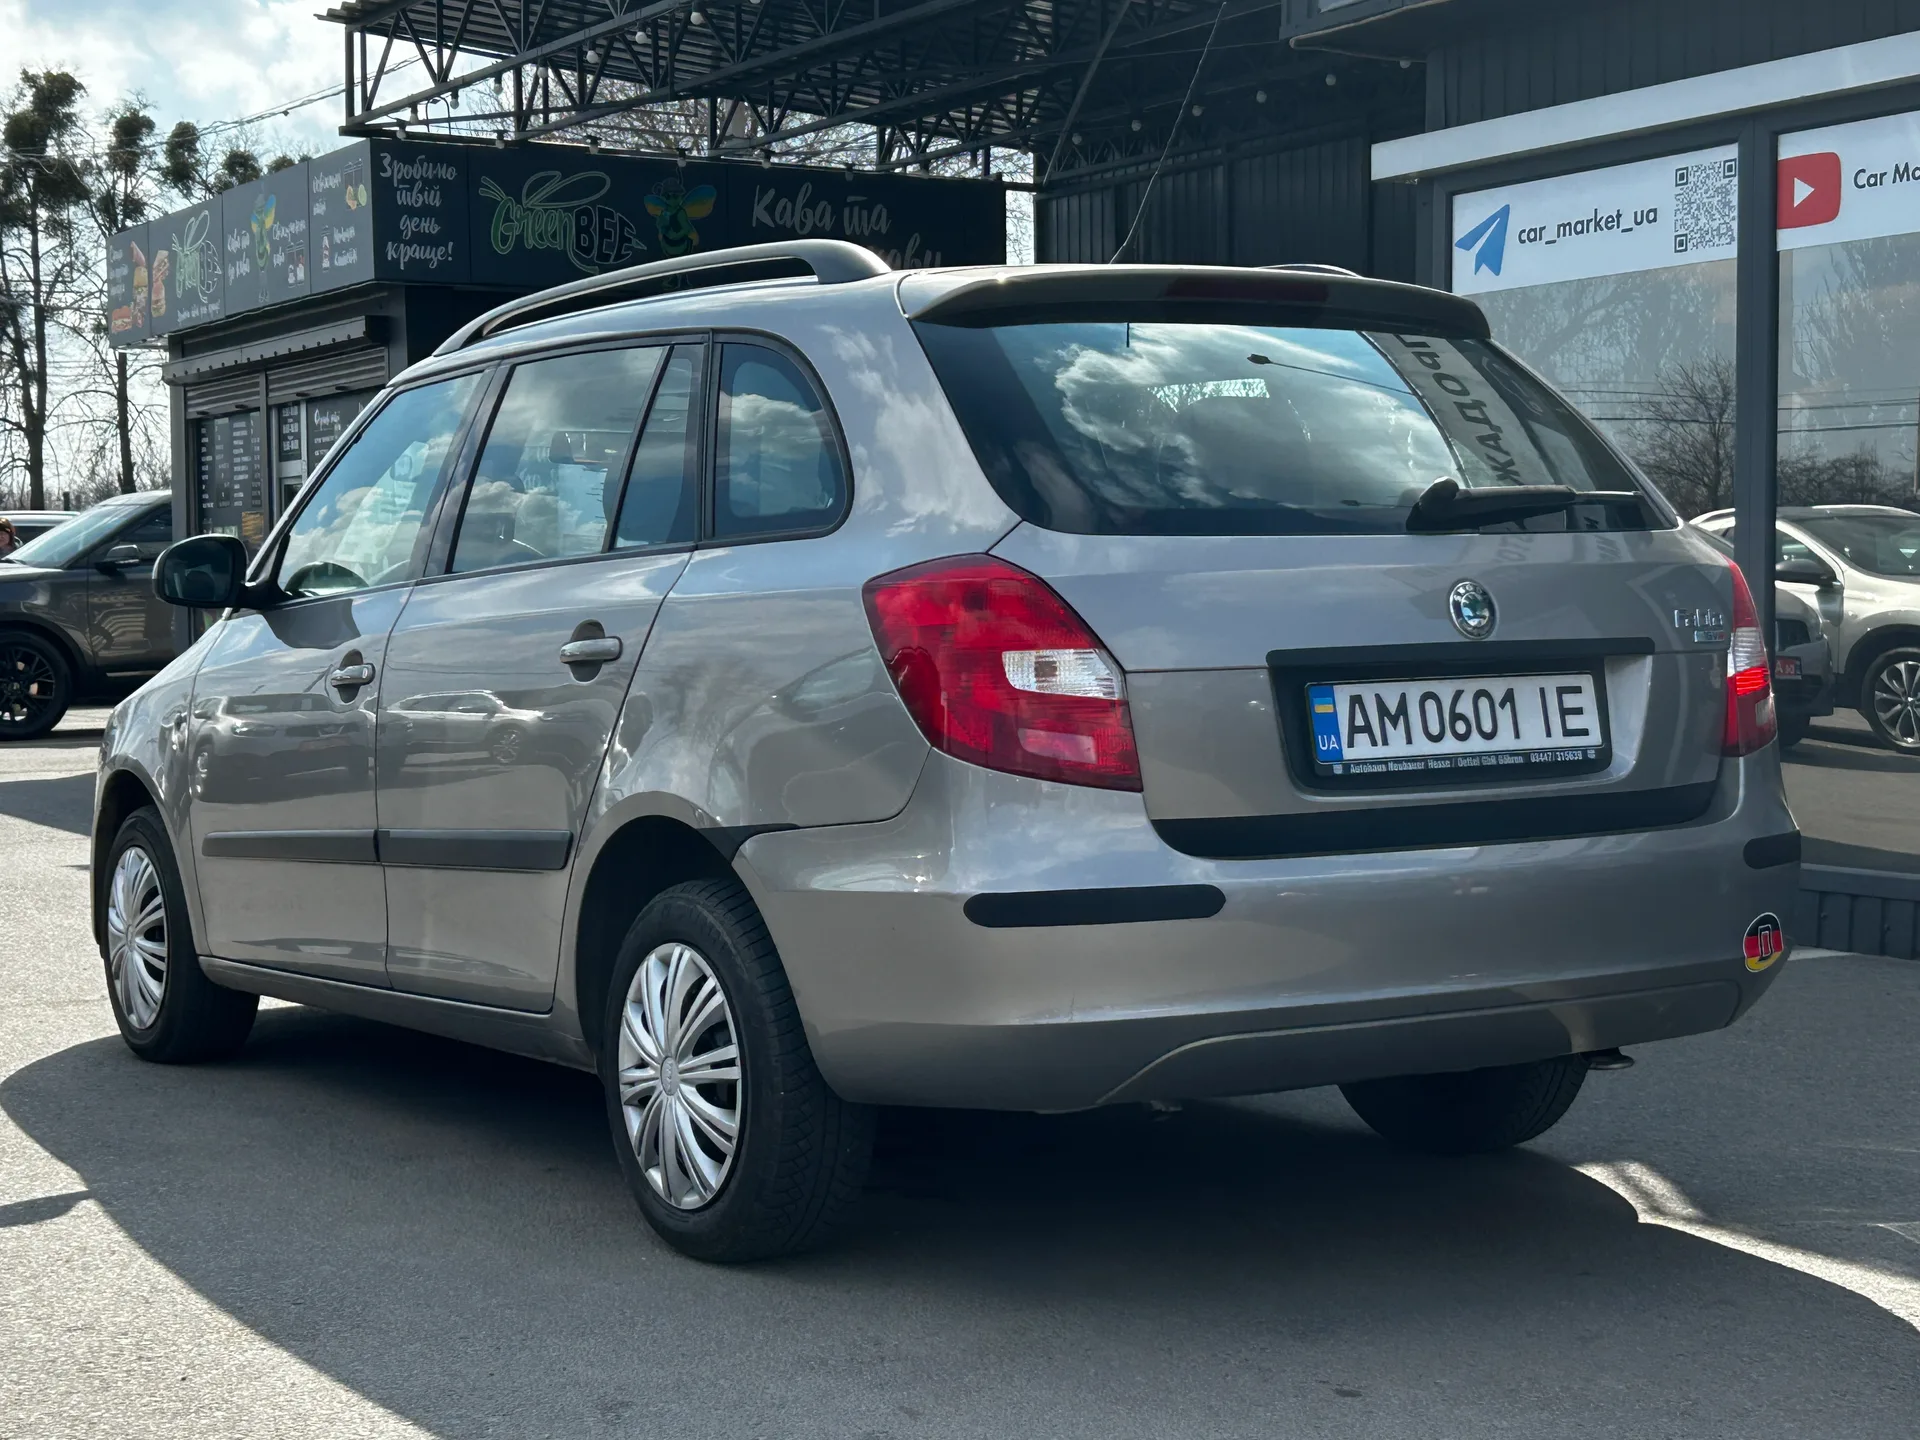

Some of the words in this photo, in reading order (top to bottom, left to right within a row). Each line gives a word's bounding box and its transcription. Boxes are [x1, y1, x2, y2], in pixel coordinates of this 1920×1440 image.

[380, 152, 458, 188] Зробимо
[1853, 168, 1888, 190] Car
[396, 180, 443, 208] твій
[752, 181, 836, 236] Кава
[843, 195, 892, 237] та
[400, 214, 442, 241] день
[1517, 207, 1658, 246] car_market_ua
[385, 241, 454, 271] краще!
[1318, 734, 1340, 751] UA
